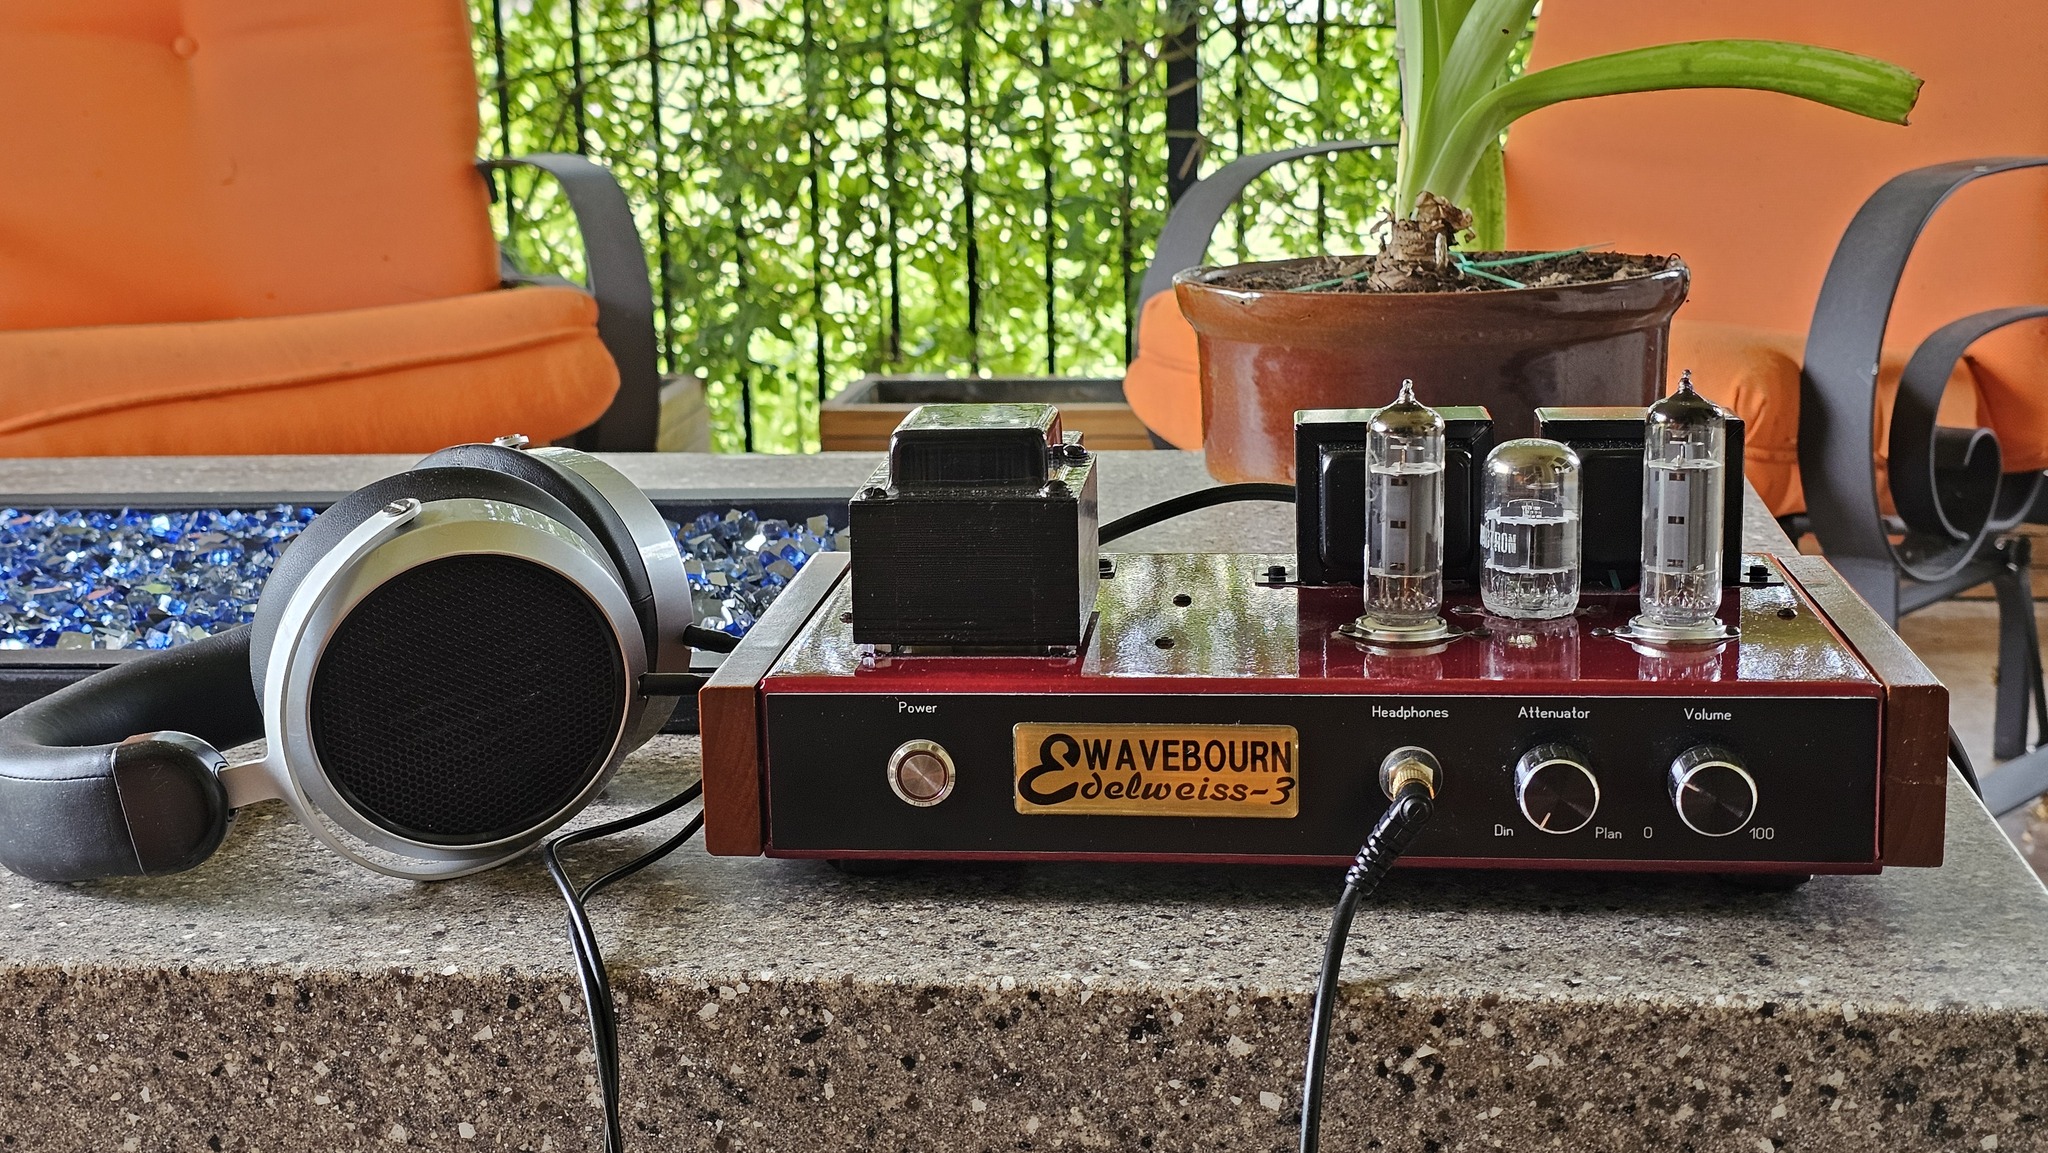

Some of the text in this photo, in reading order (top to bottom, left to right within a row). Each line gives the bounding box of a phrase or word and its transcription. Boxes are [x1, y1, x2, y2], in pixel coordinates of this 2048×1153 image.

[898, 701, 938, 714] Power
[1371, 705, 1449, 720] Headphones
[1517, 706, 1590, 720] Attenuator
[1683, 707, 1732, 721] Volume
[1082, 738, 1292, 773] WAVEBOURN
[1493, 824, 1514, 838] Din
[1595, 826, 1622, 840] Plan
[1643, 826, 1653, 840] 0
[1749, 827, 1775, 841] 100
